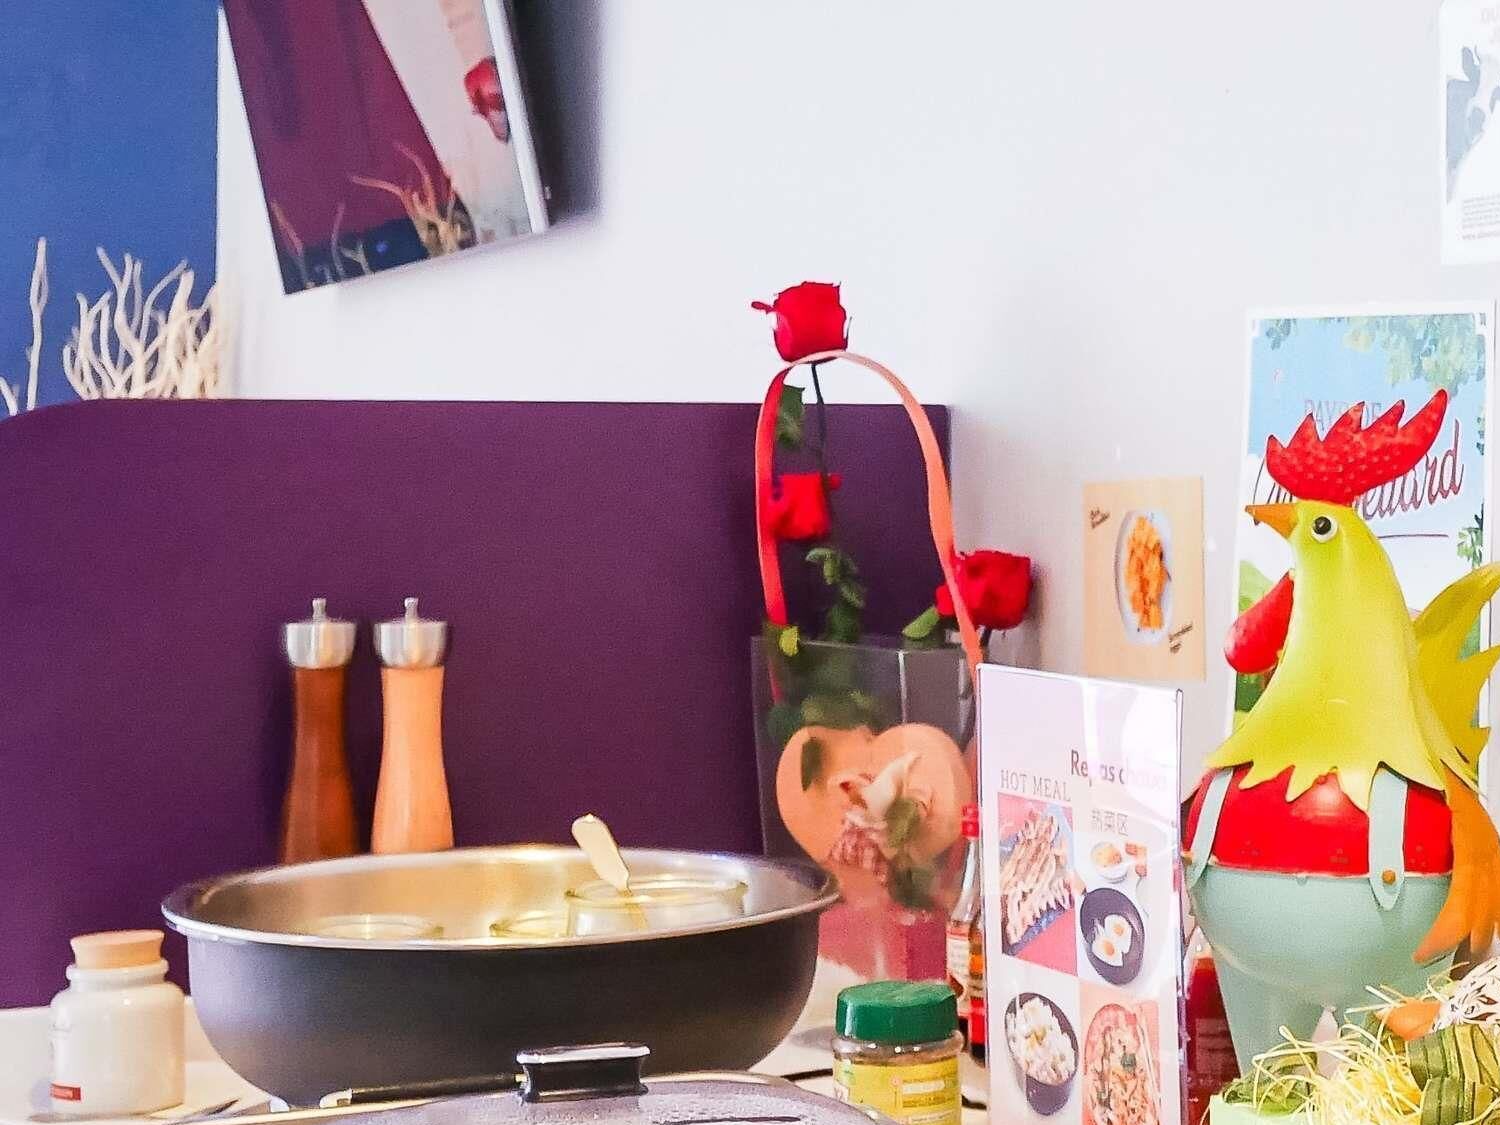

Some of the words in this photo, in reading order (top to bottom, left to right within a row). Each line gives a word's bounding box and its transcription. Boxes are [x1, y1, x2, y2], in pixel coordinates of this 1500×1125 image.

[1071, 750, 1114, 786] Reas
[1000, 770, 1027, 792] HOT
[1031, 777, 1071, 802] MEAL
